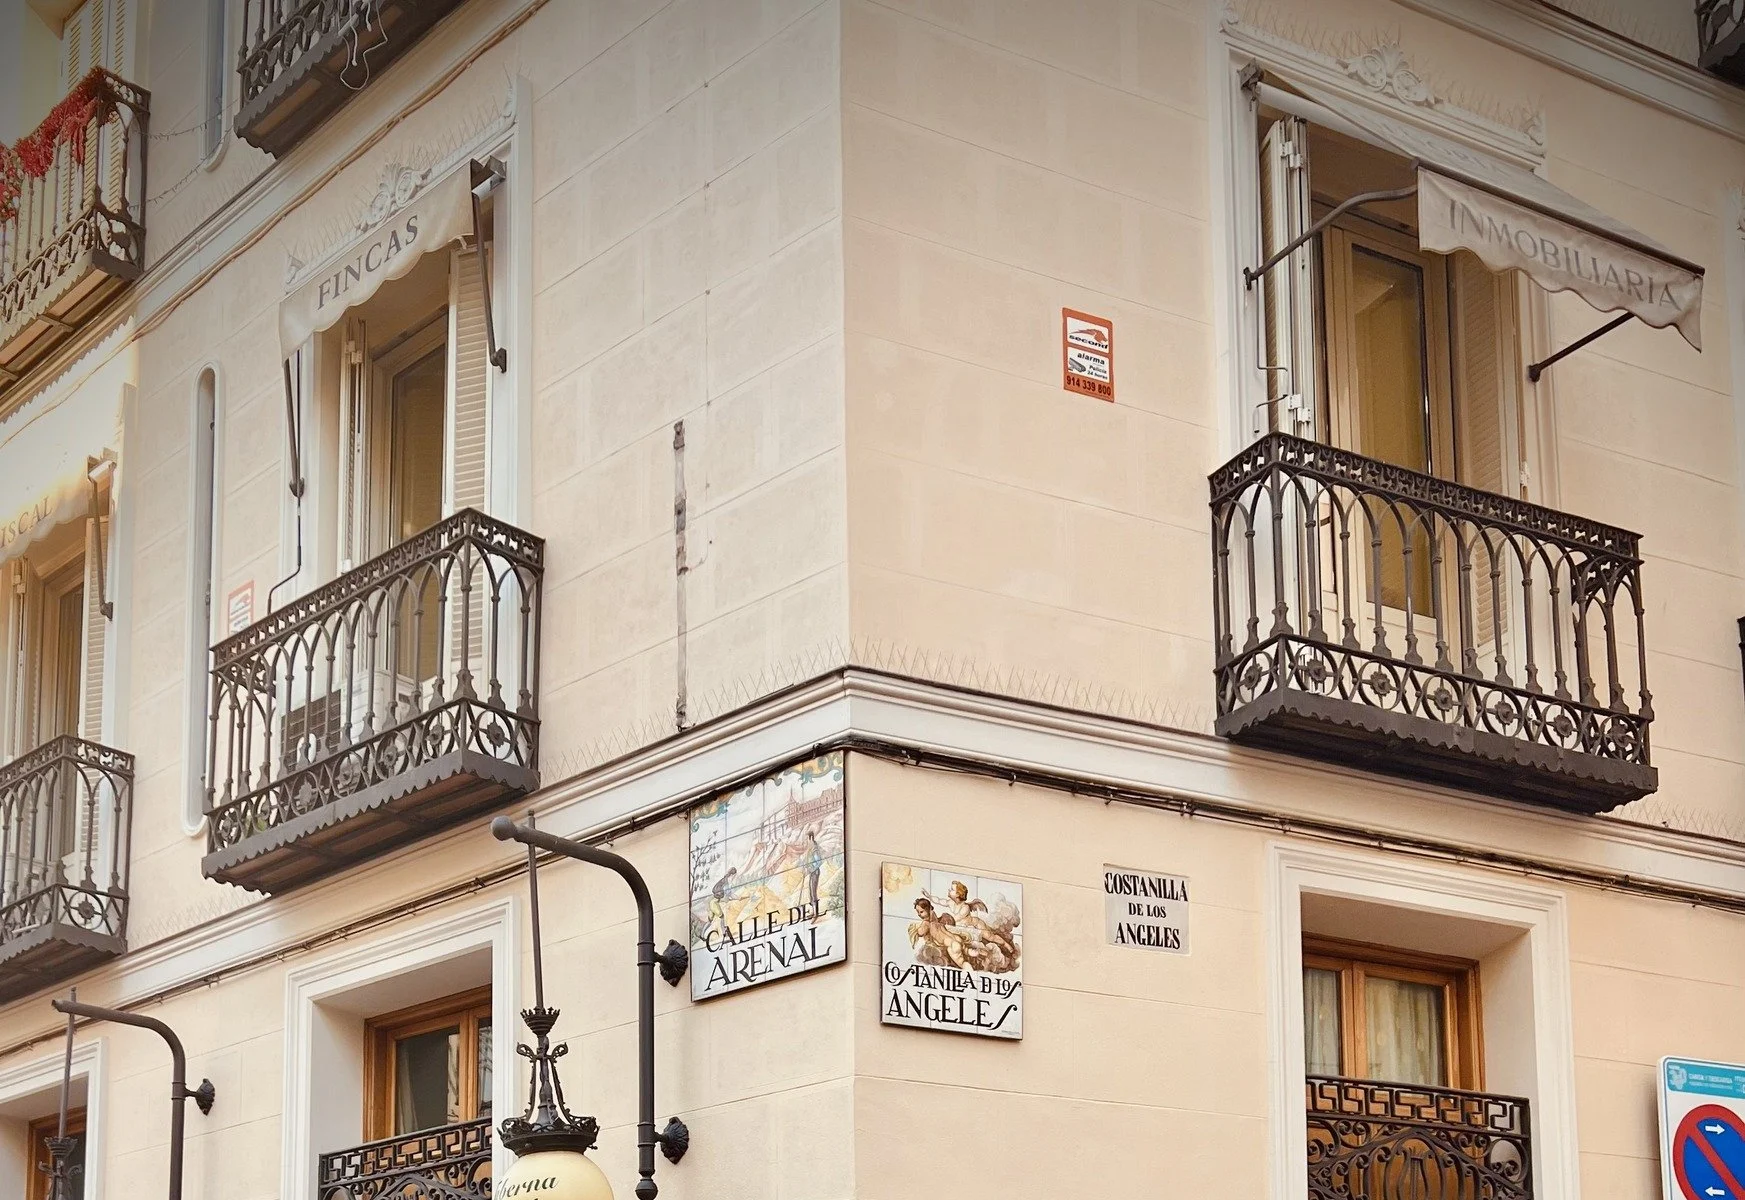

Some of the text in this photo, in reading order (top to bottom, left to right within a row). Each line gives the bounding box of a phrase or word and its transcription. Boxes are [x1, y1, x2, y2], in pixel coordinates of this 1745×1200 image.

[317, 215, 418, 310] FINCAS
[1450, 199, 1682, 311] INMOBILIARIA
[1069, 335, 1108, 349] second
[1077, 353, 1105, 365] alarma
[1066, 376, 1080, 387] 914
[1083, 380, 1096, 392] 339
[1104, 872, 1188, 902] COSTANILLA
[1128, 902, 1167, 918] DE LOS
[705, 899, 828, 953] CALLE DEL
[1115, 922, 1180, 949] ANGELES
[704, 927, 832, 991] ARENAL
[885, 988, 1018, 1030] ANGELES
